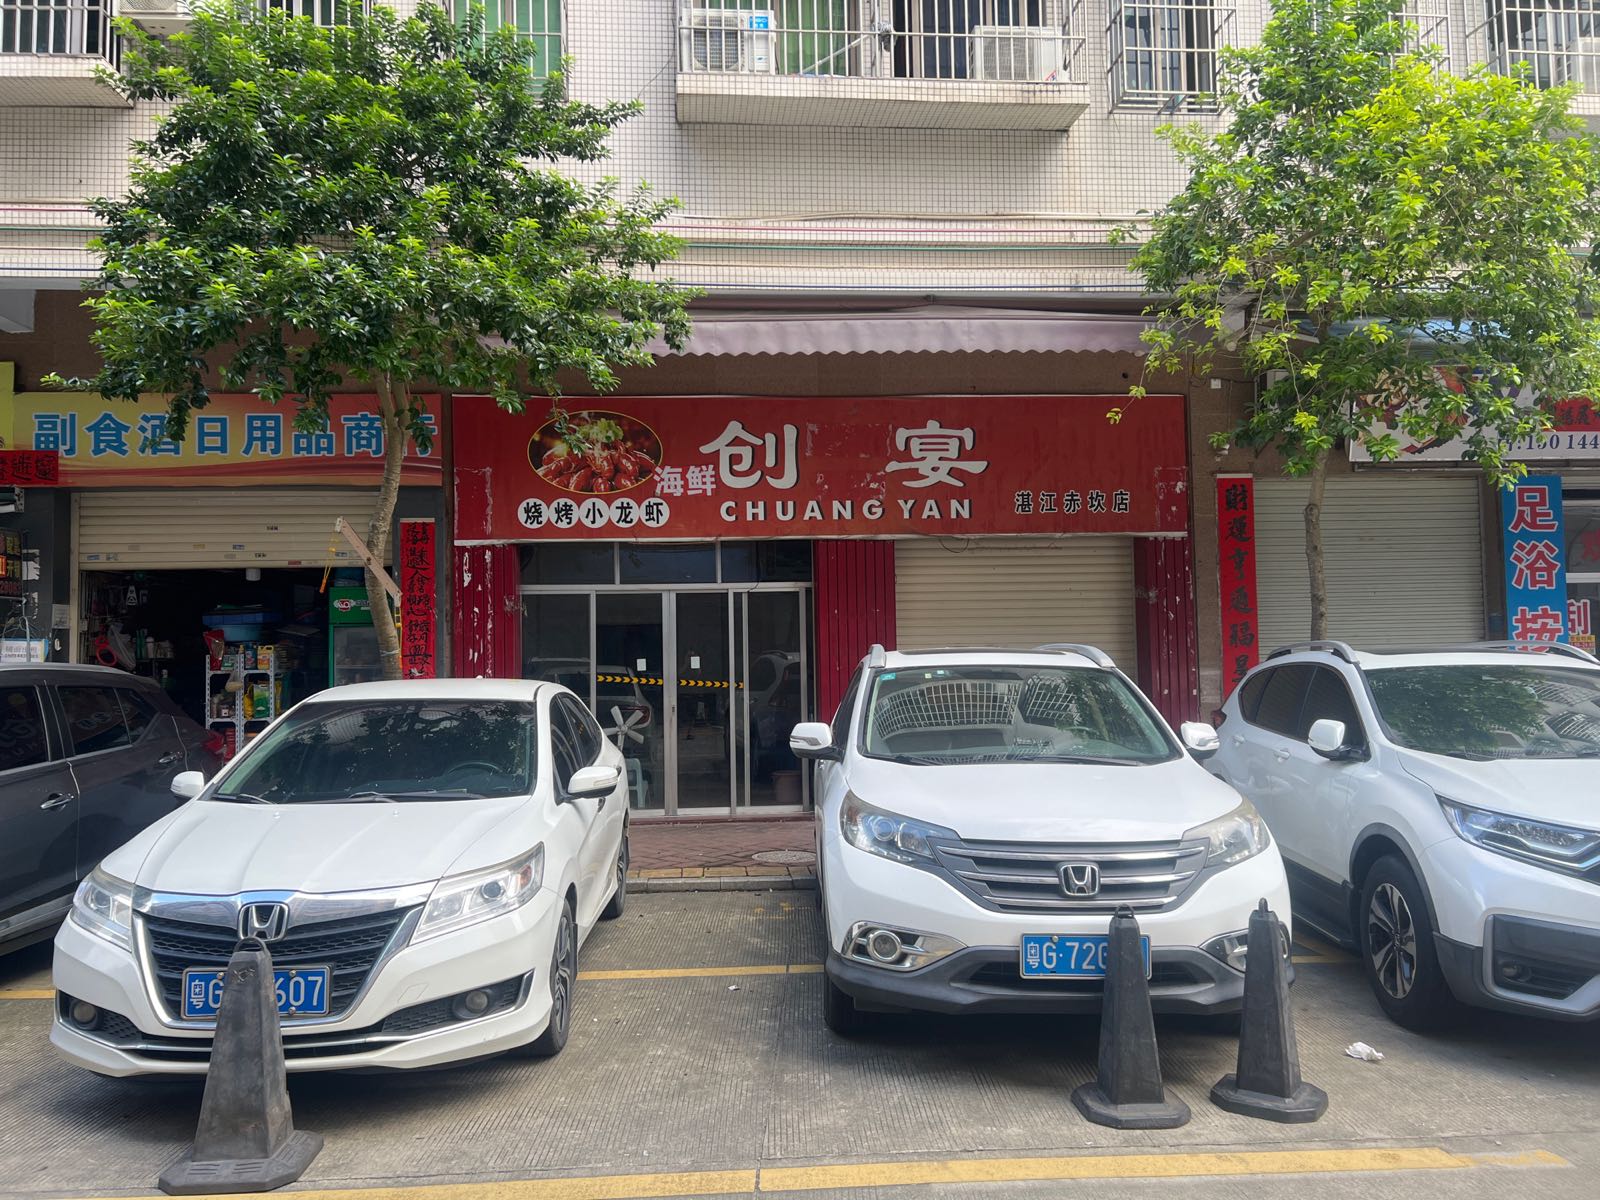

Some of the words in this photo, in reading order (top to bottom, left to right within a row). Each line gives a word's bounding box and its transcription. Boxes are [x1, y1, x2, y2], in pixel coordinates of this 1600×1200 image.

[654, 465, 718, 497] 海鲜
[522, 501, 665, 526] 烧烤小龙虾
[720, 500, 885, 522] CHUANG
[897, 499, 973, 520] YAN
[1014, 490, 1132, 514] 湛江赤坎店
